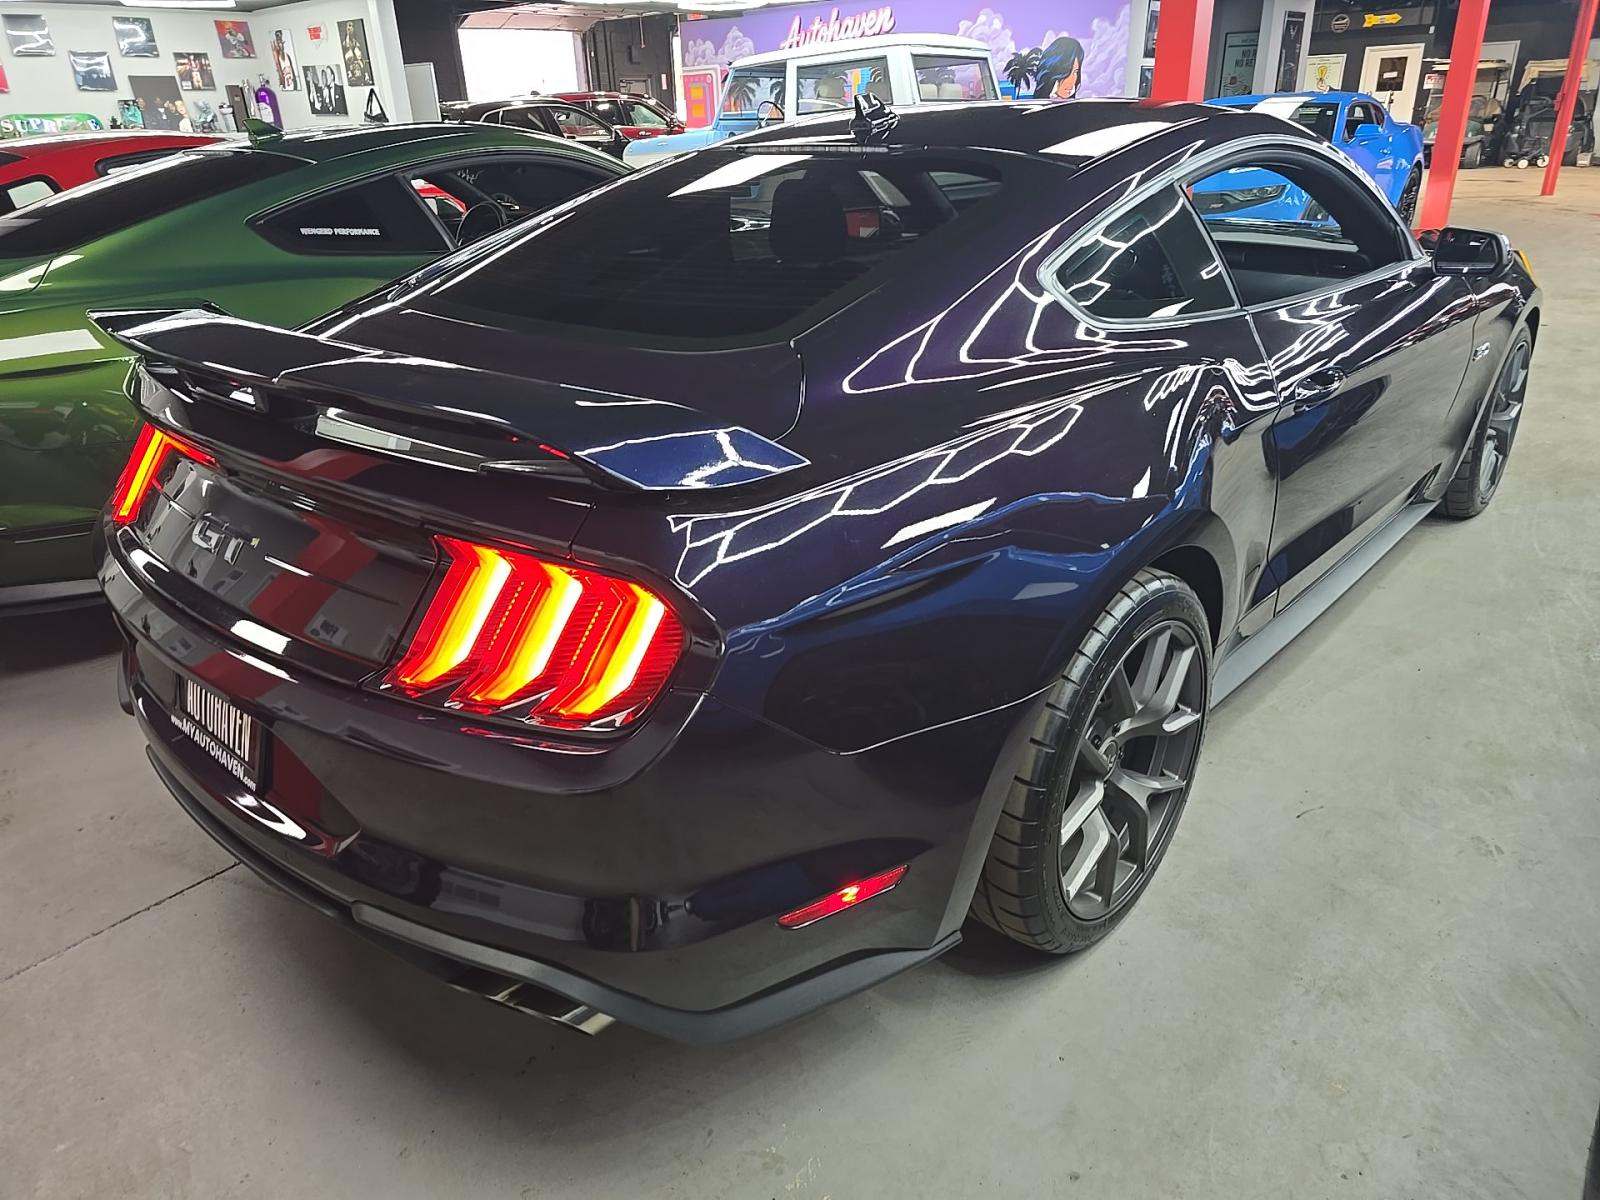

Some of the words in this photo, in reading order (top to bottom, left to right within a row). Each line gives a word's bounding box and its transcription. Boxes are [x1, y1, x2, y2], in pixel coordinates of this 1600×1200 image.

[778, 6, 896, 50] Autohaven
[334, 228, 381, 236] PERFORMANCE
[191, 519, 245, 566] GT
[186, 679, 252, 762] AUTOHAVEN
